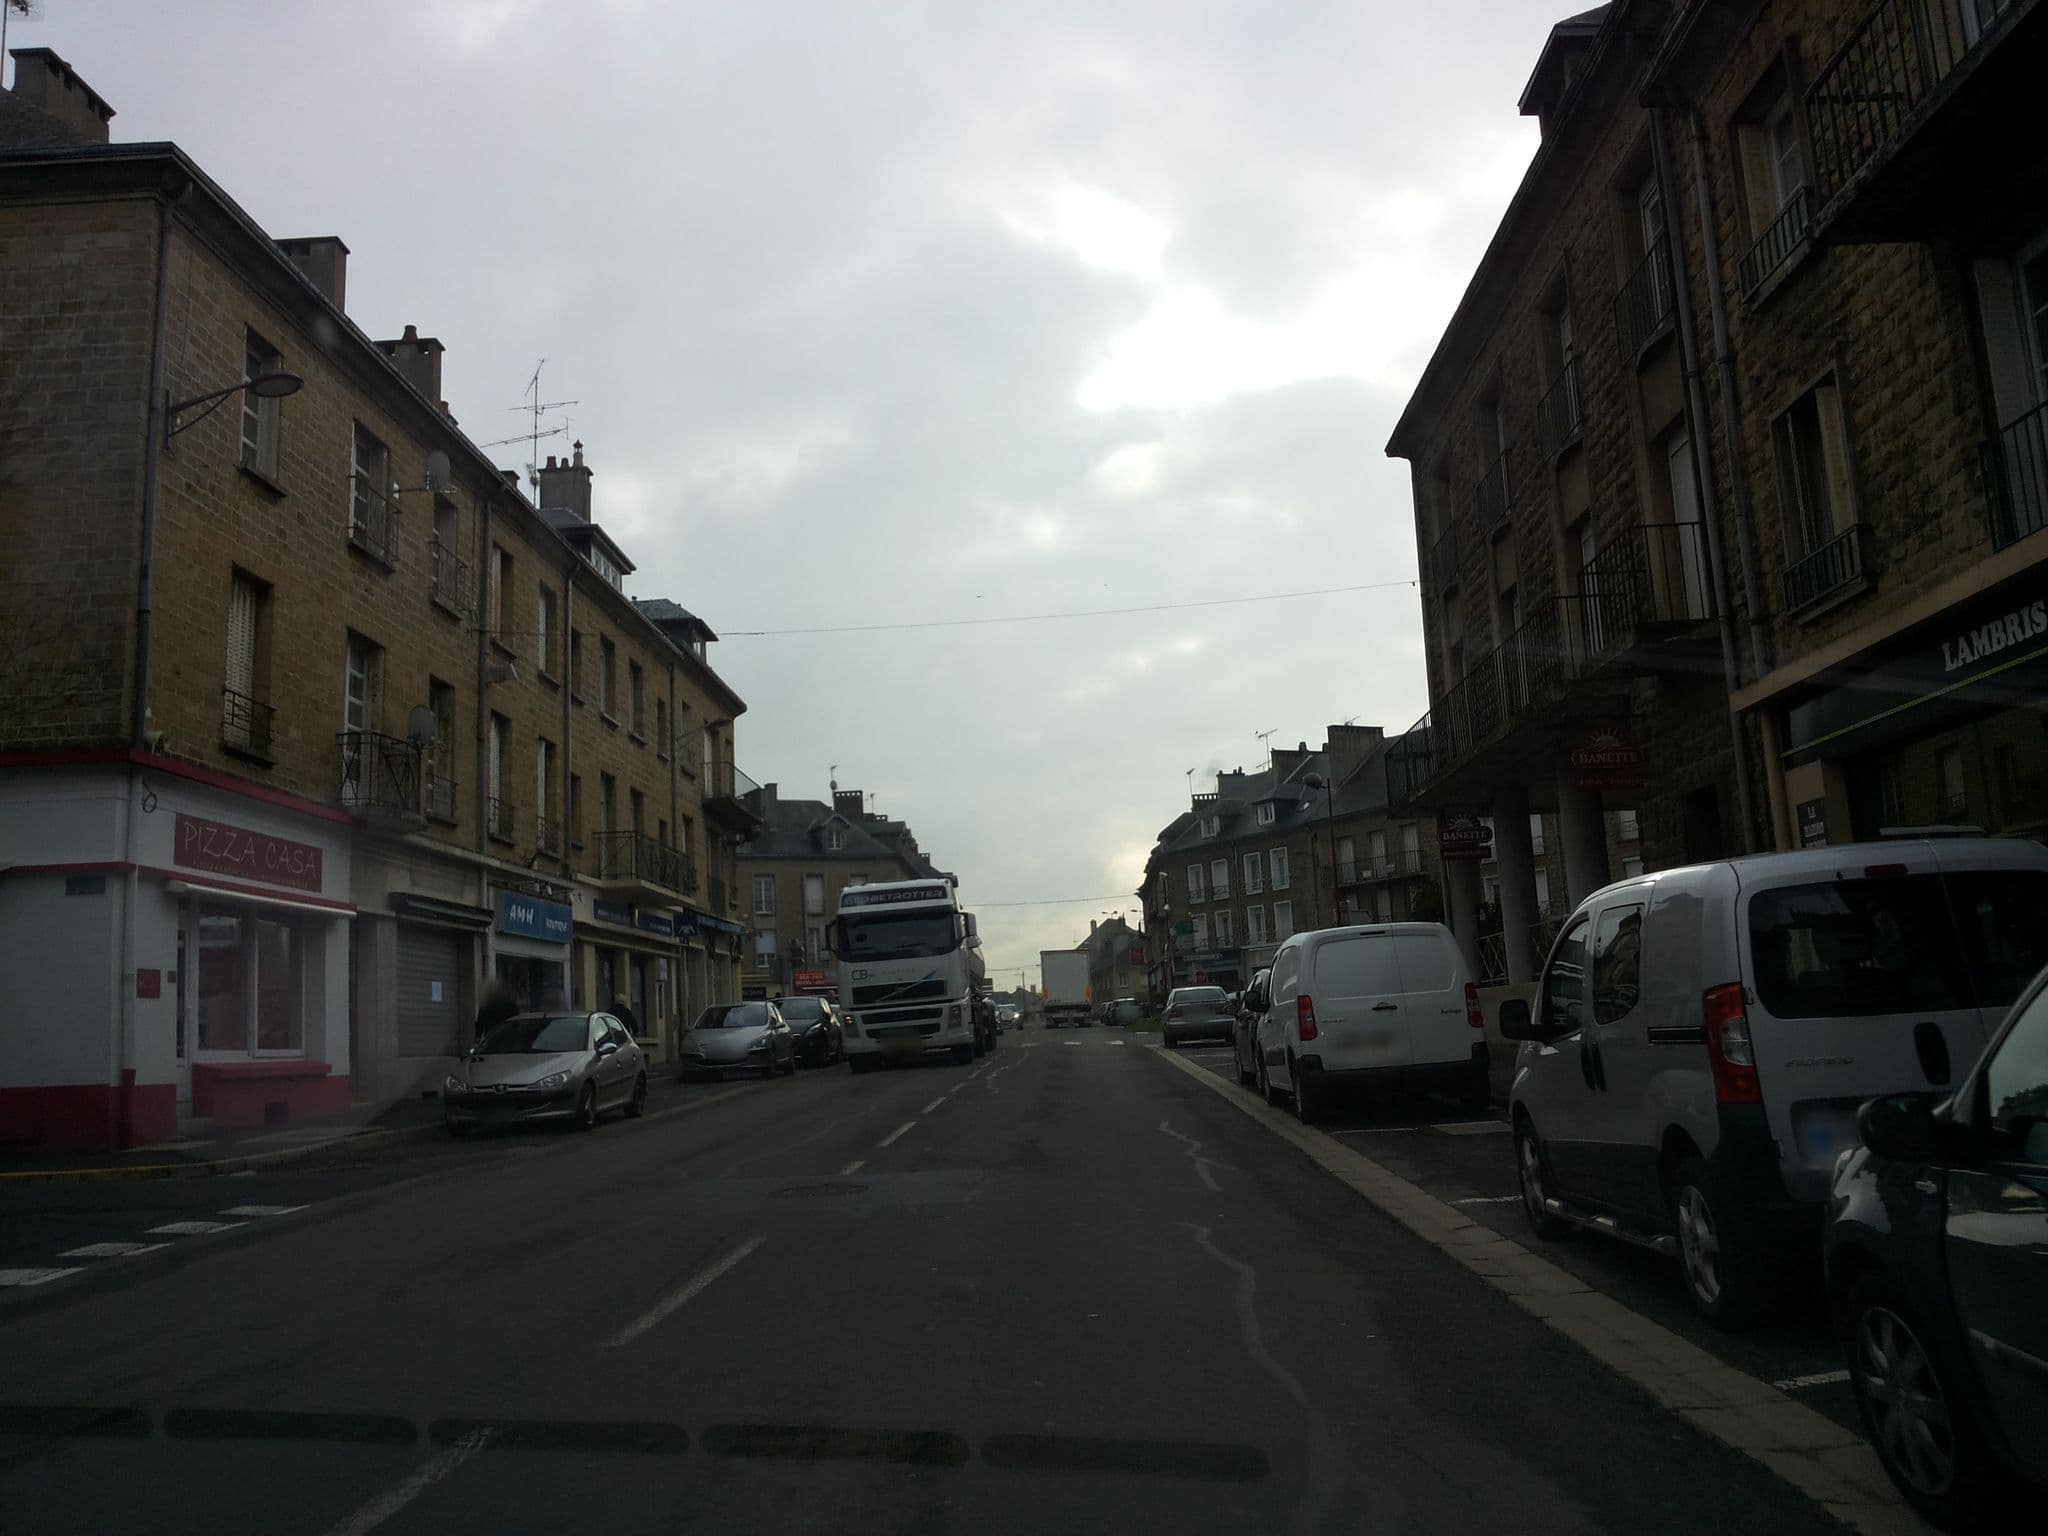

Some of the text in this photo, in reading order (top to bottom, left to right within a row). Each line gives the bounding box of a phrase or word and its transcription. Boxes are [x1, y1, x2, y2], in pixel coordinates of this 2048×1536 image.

[1942, 600, 2048, 672] LAMBRIS
[184, 821, 256, 865] PIZZA
[265, 842, 317, 879] CASA
